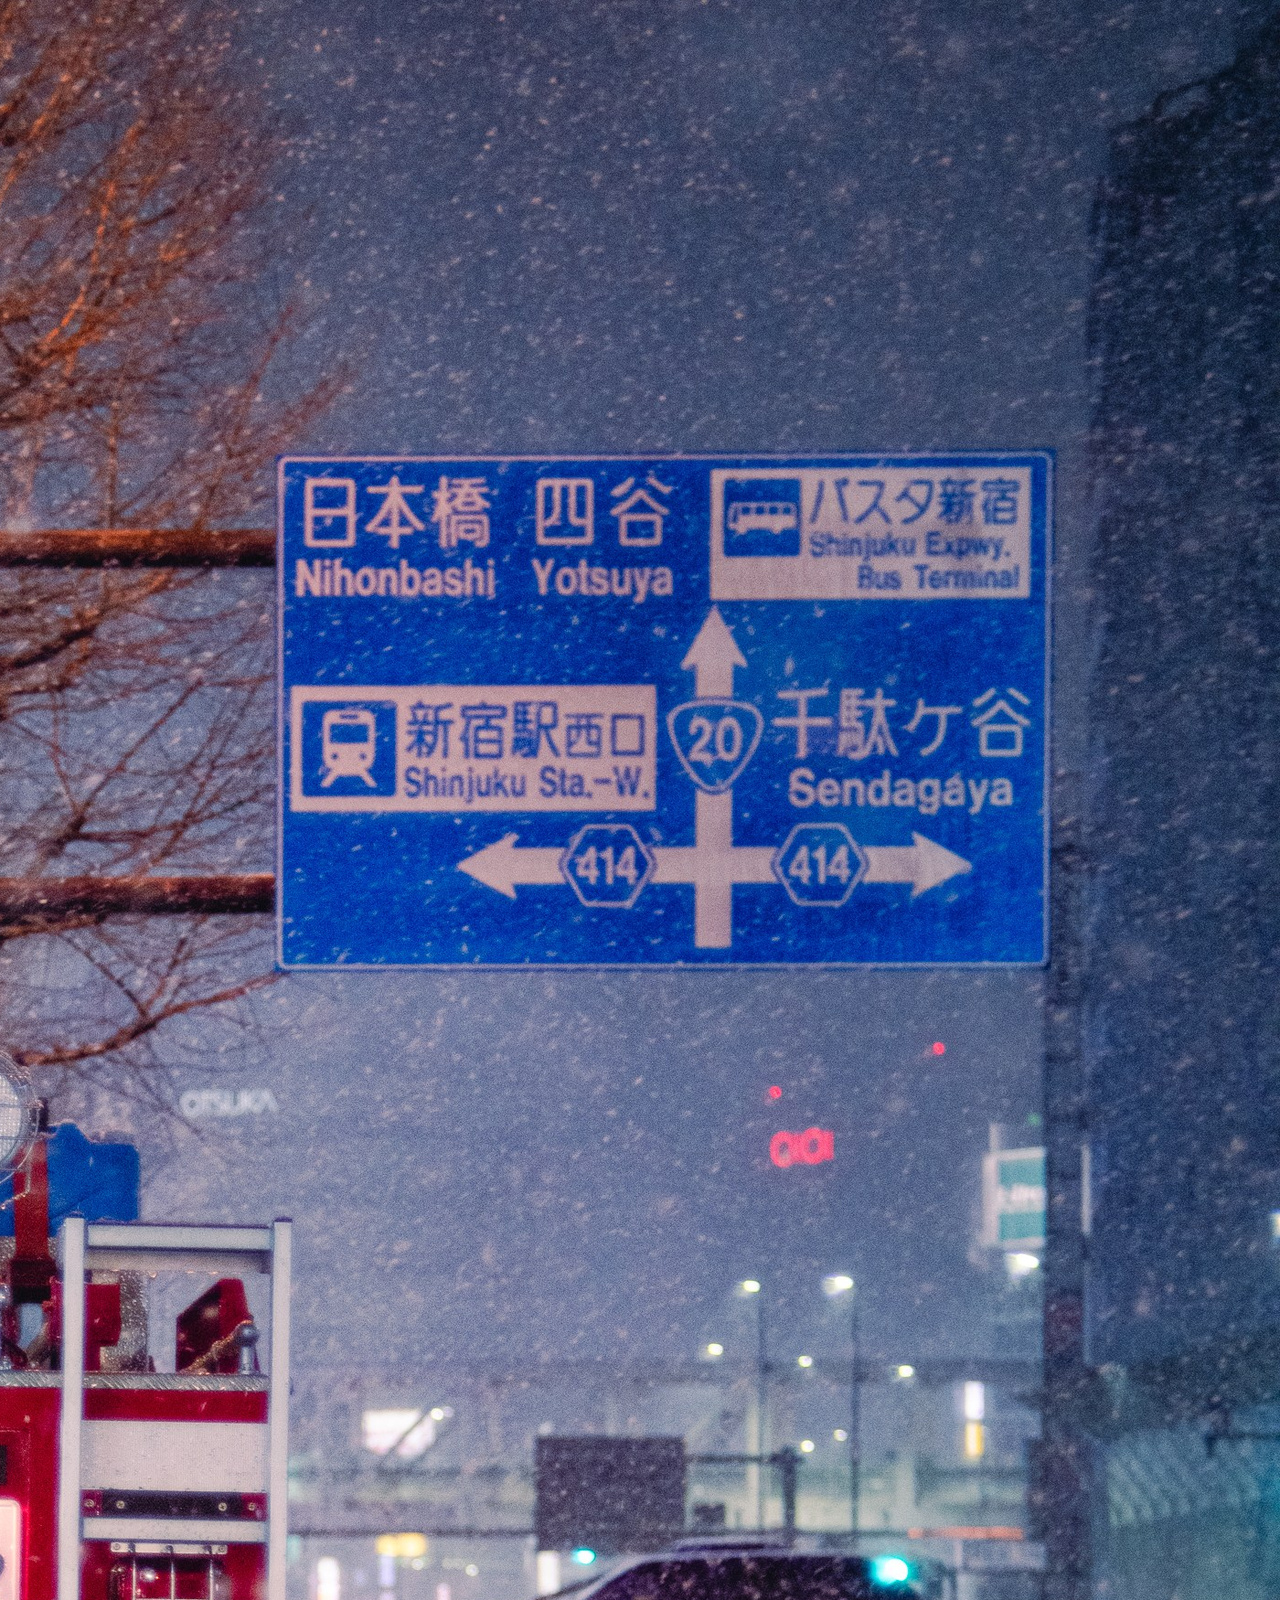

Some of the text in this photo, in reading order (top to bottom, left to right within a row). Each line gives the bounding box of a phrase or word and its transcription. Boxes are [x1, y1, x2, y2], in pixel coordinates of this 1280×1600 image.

[303, 476, 491, 550] 日本橋
[535, 476, 673, 548] 四谷
[811, 478, 1021, 527] バスタ新宿
[809, 532, 1012, 562] Shinjuku Expwy.
[295, 559, 496, 598] Nihonbashi
[531, 561, 673, 604] Yotsuya
[857, 563, 1020, 591] Bus Terminal
[406, 700, 646, 760] 新宿駅西口
[687, 716, 744, 763] 20
[404, 767, 651, 802] Shinjuku Sta.-W.
[788, 768, 1013, 814] Sendagaya
[577, 848, 639, 884] 414
[787, 848, 850, 884] 414
